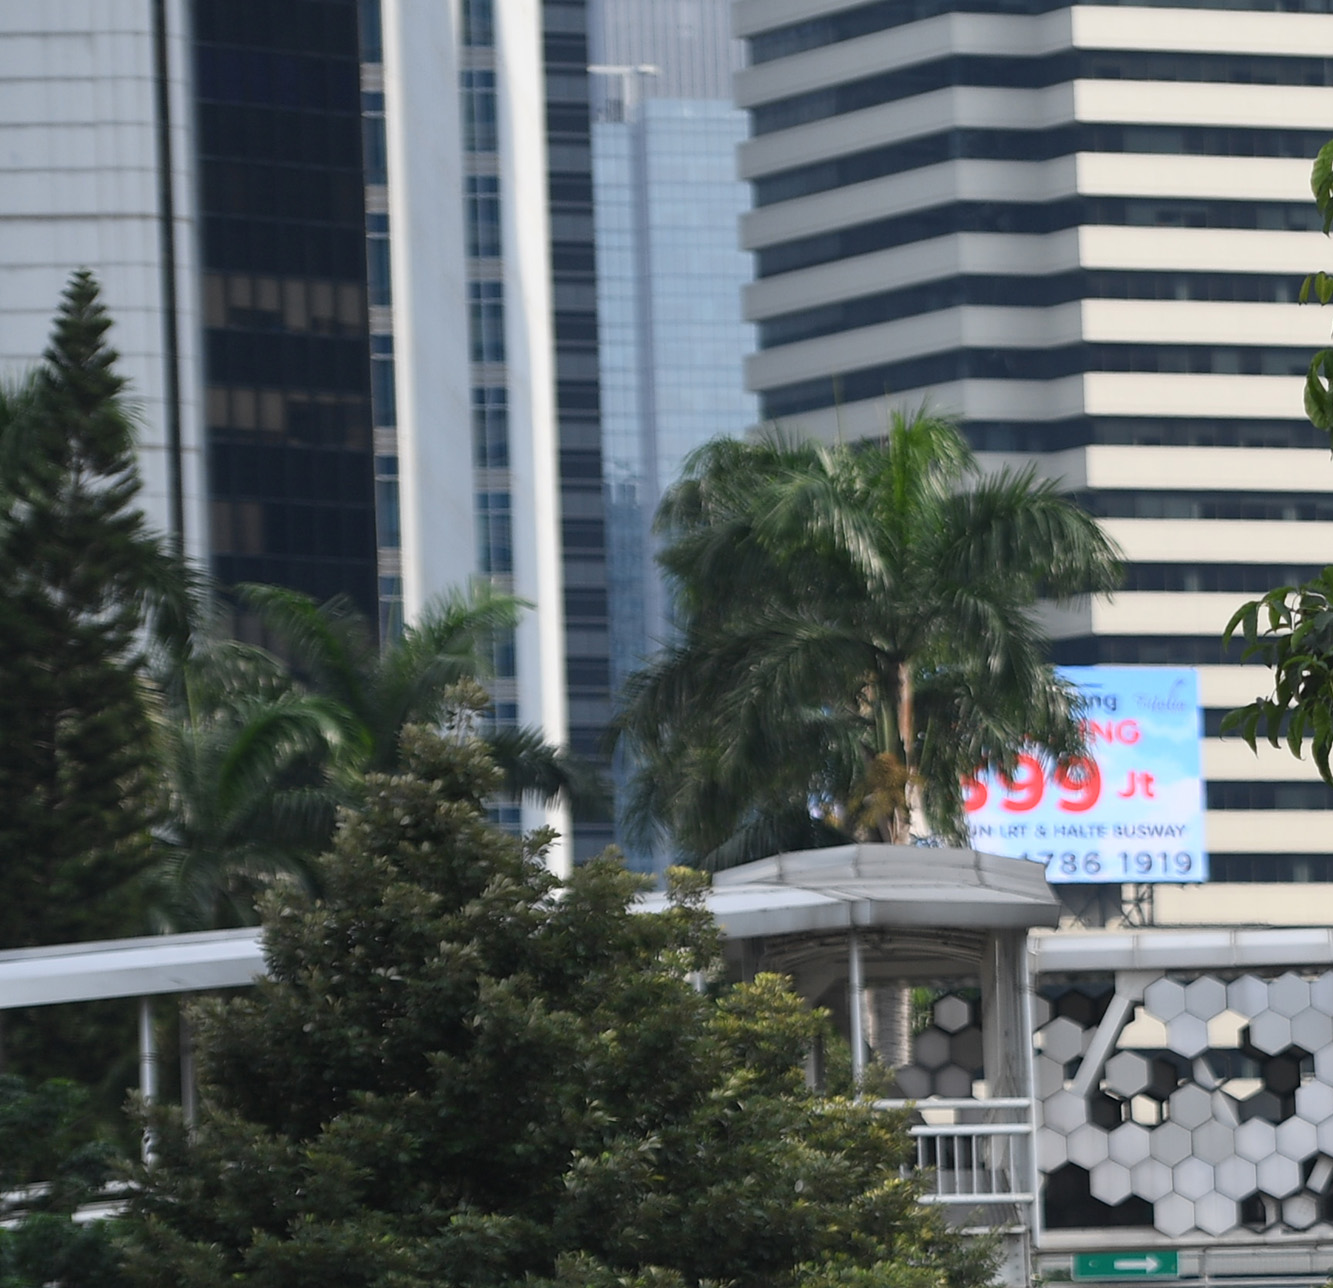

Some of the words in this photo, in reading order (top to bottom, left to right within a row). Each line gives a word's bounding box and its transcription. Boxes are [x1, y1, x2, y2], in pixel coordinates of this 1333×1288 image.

[1053, 824, 1108, 838] HALTE
[1112, 823, 1186, 838] BUSWAY
[1119, 851, 1193, 875] 1919
